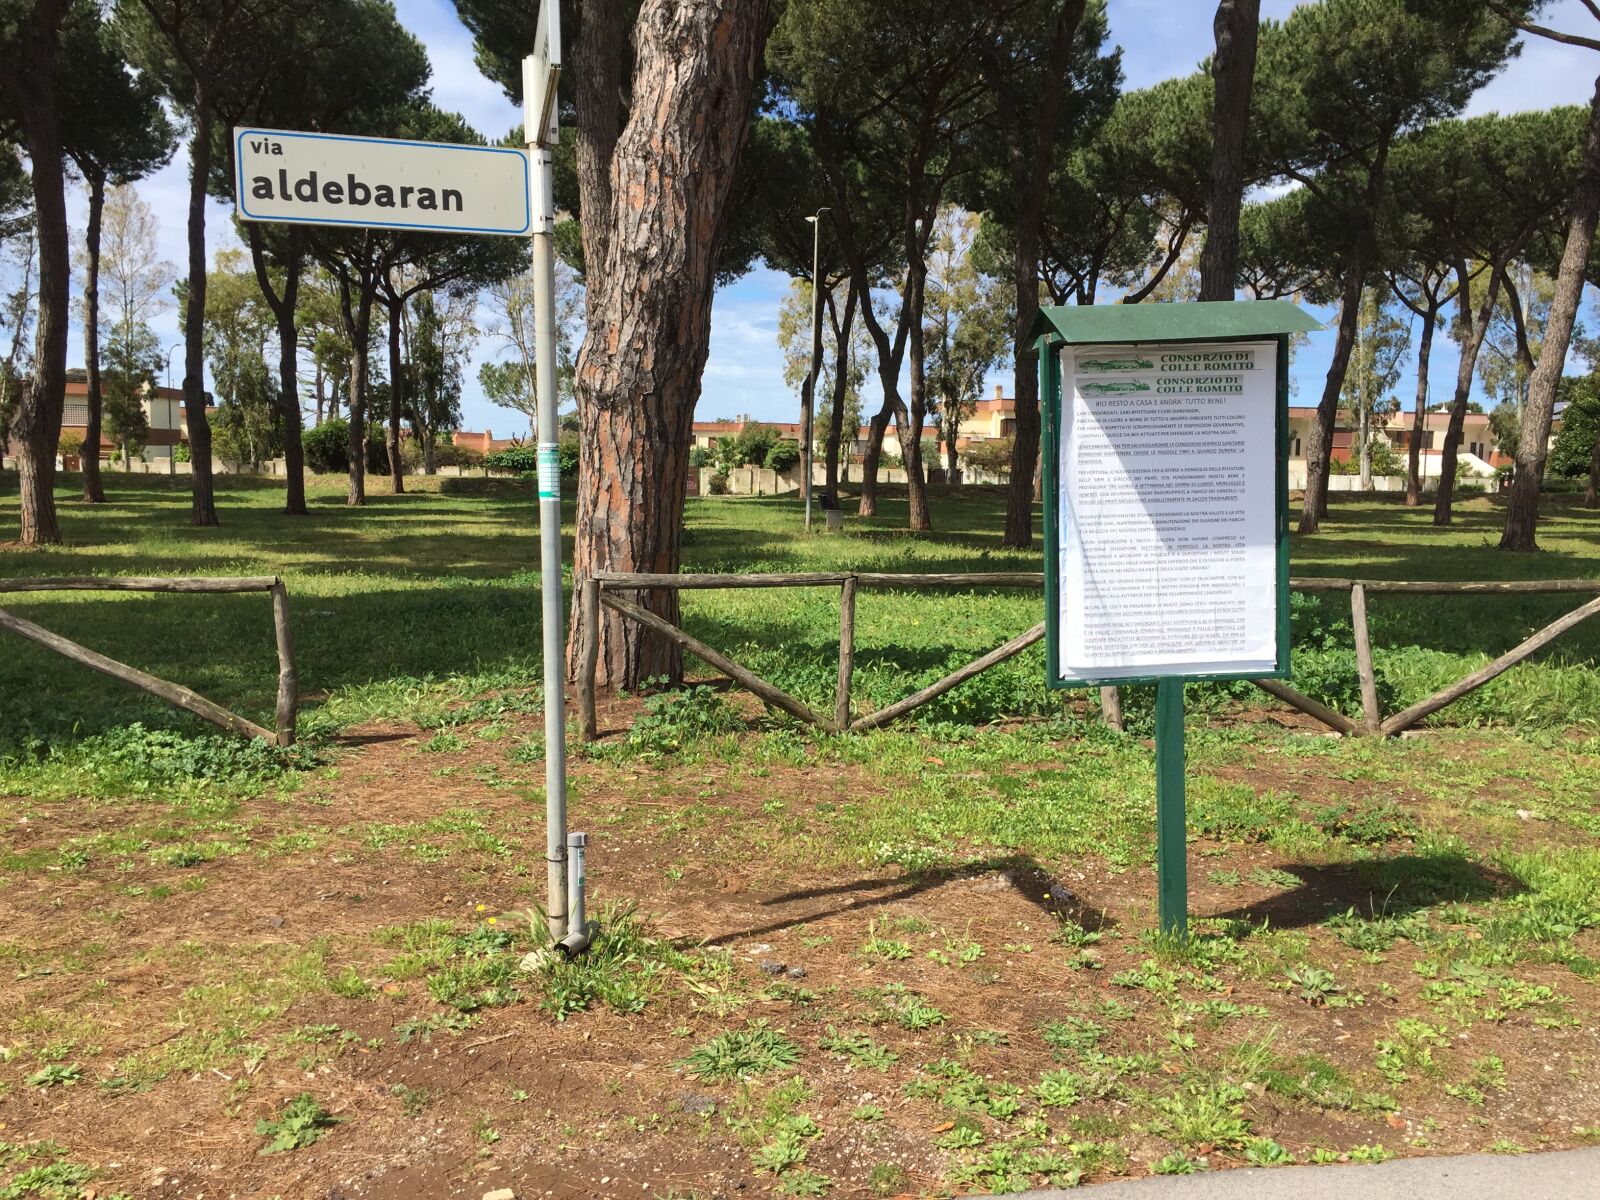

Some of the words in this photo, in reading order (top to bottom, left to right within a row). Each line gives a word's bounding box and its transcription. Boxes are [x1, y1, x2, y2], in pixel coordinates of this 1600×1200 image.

[251, 137, 283, 156] via
[252, 169, 464, 212] aldebaran
[1161, 353, 1233, 363] CONSORZIO
[1235, 353, 1249, 361] DI
[1161, 363, 1201, 372] COLLE
[1203, 361, 1254, 371] ROMITO
[1156, 376, 1222, 386] CONSORZIO
[1225, 376, 1238, 384] DI
[1156, 385, 1194, 394] COLLE
[1196, 384, 1243, 393] ROMITO
